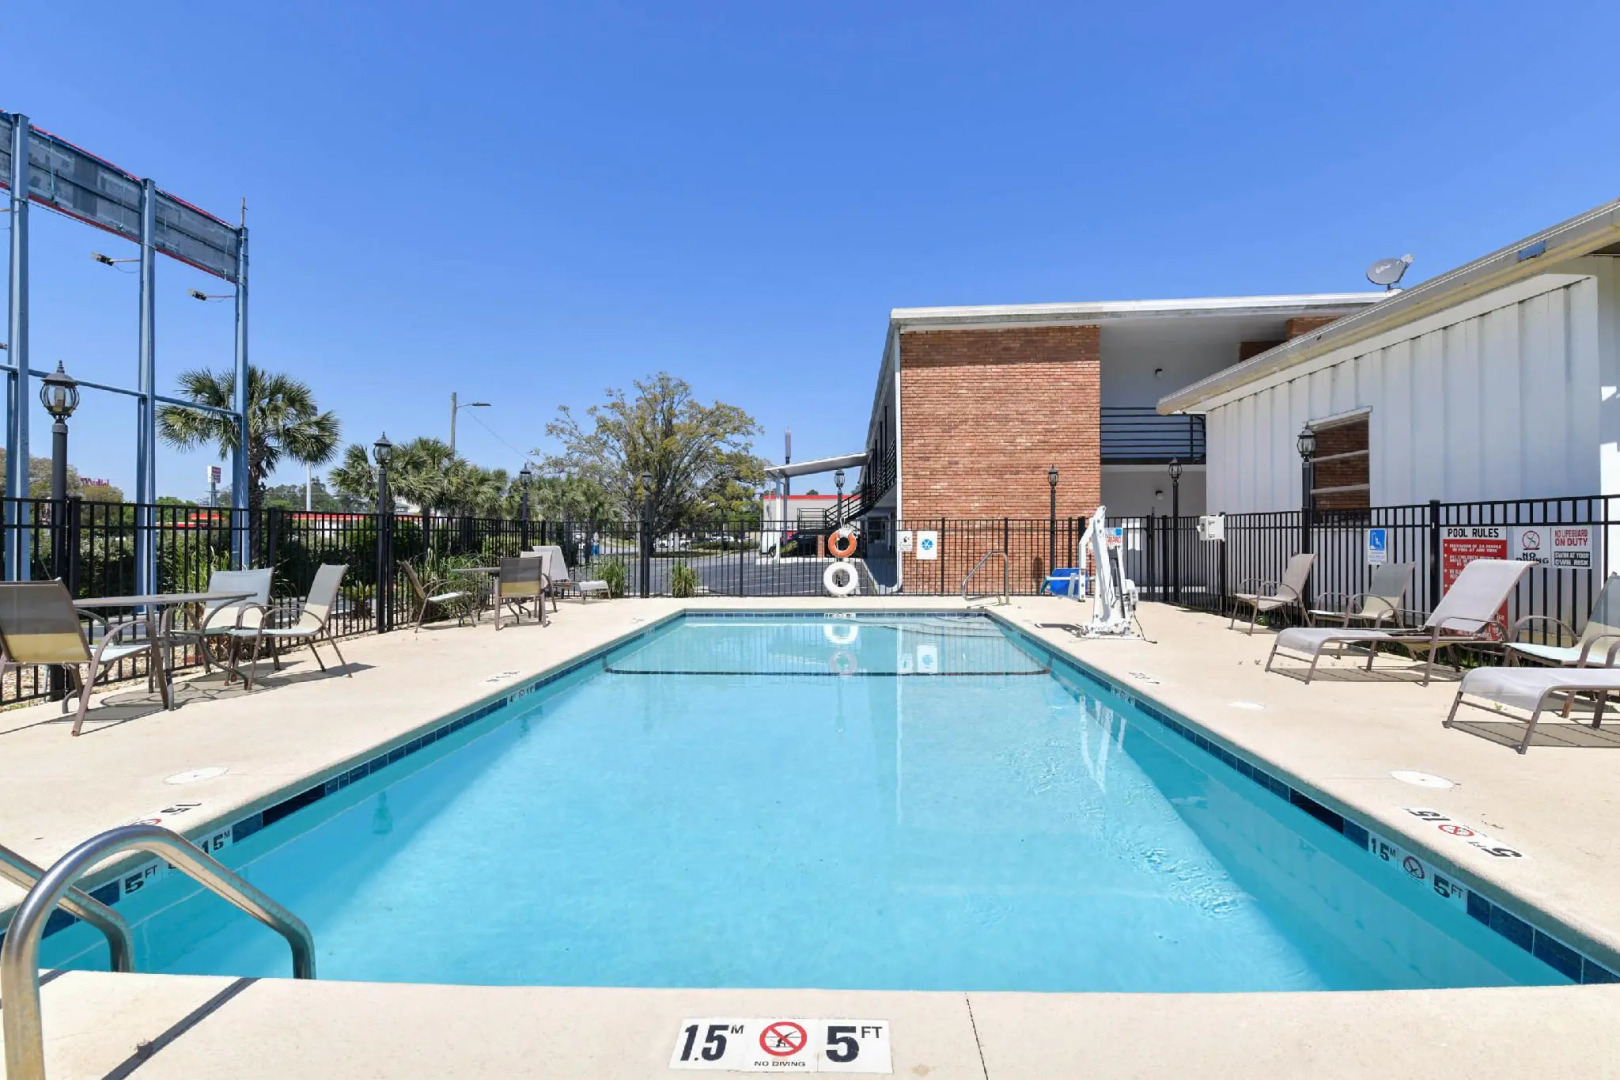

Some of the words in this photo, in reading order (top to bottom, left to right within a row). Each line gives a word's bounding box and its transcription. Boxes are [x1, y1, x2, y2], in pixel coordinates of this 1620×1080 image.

[1447, 528, 1468, 538] POOL
[1472, 528, 1499, 538] RULES
[1555, 529, 1561, 538] NO
[1562, 529, 1589, 538] LIFEGUARD
[1555, 538, 1565, 546] ON
[1567, 538, 1589, 546] DUTY
